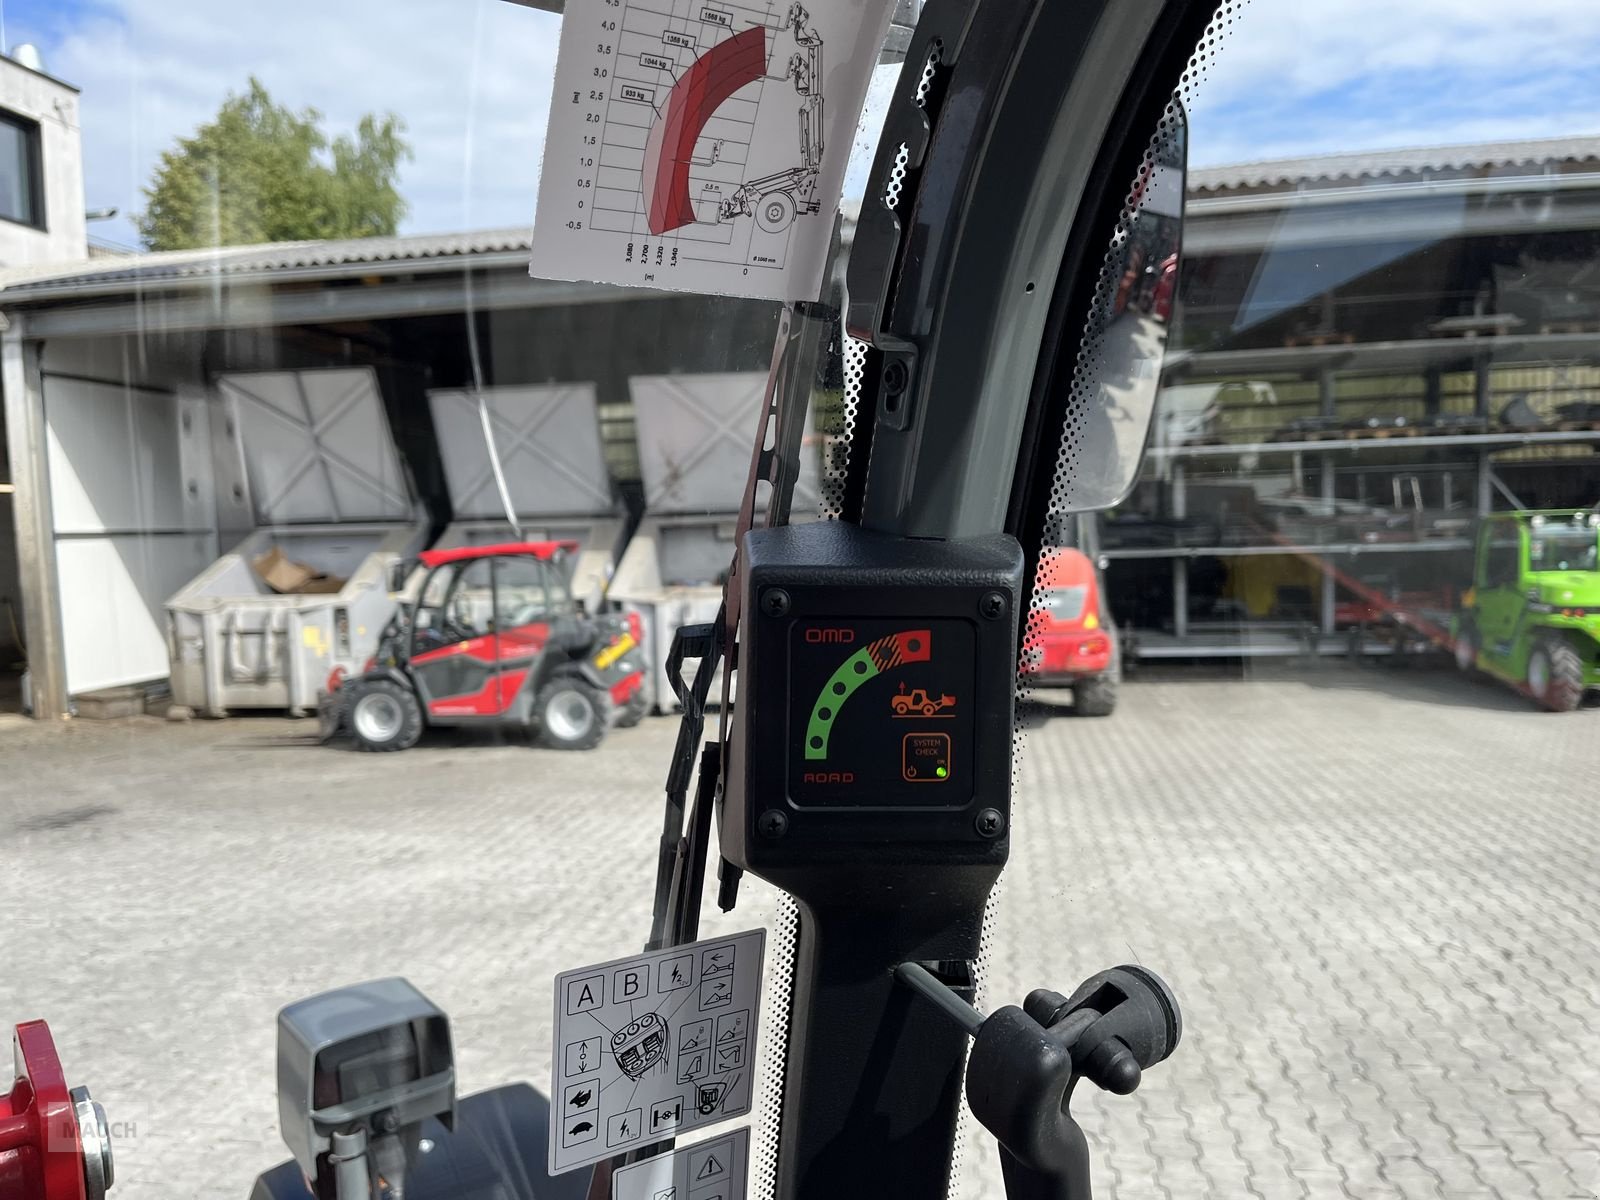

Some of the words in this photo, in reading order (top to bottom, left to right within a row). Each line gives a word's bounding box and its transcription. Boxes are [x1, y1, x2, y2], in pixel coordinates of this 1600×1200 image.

[602, 20, 615, 31] 4,0
[597, 44, 611, 54] 3,5
[594, 67, 607, 77] 3,0
[590, 90, 604, 101] 2,5
[586, 113, 600, 123] 2,0
[583, 136, 596, 145] 1,5
[580, 157, 593, 167] 1,0
[577, 179, 591, 188] 0,5
[578, 200, 584, 208] 0
[565, 220, 582, 230] -0,5
[625, 242, 634, 263] 3,080
[640, 244, 649, 264] 2,700
[655, 246, 664, 266] 2,320
[742, 268, 748, 276] 0
[805, 629, 854, 643] OMD
[912, 739, 941, 747] SYSTEM
[915, 748, 938, 756] CHECK
[804, 772, 854, 783] ROAD
[624, 972, 639, 996] B
[577, 983, 594, 1008] A
